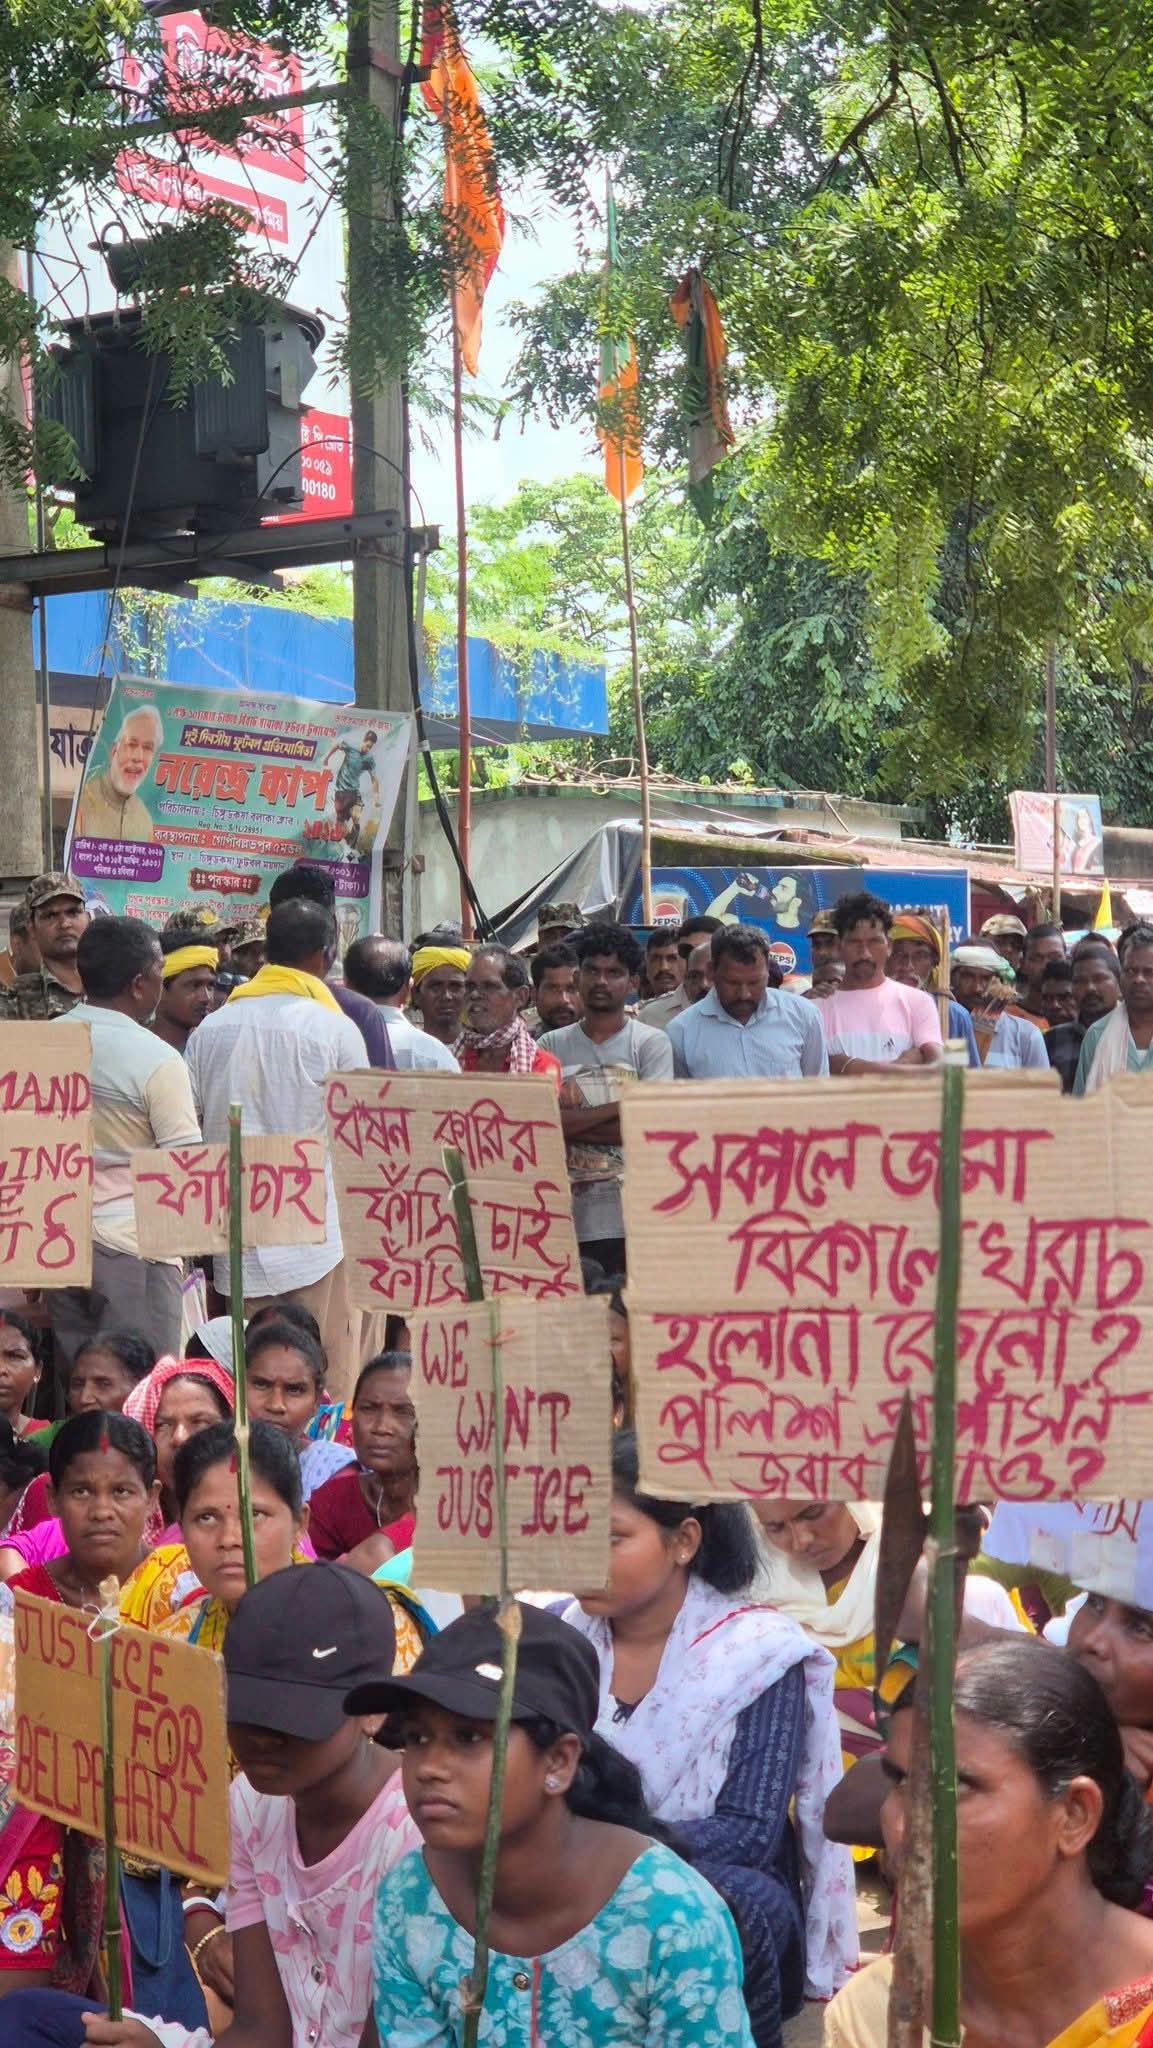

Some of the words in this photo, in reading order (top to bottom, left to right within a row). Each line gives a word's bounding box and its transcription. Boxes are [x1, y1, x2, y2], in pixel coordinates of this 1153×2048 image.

[155, 753, 256, 804] নরেন্দ্র
[258, 764, 334, 811] কাপ
[644, 1121, 883, 1222] সকালে
[421, 1319, 470, 1388] WE
[131, 1698, 209, 1784] FOR
